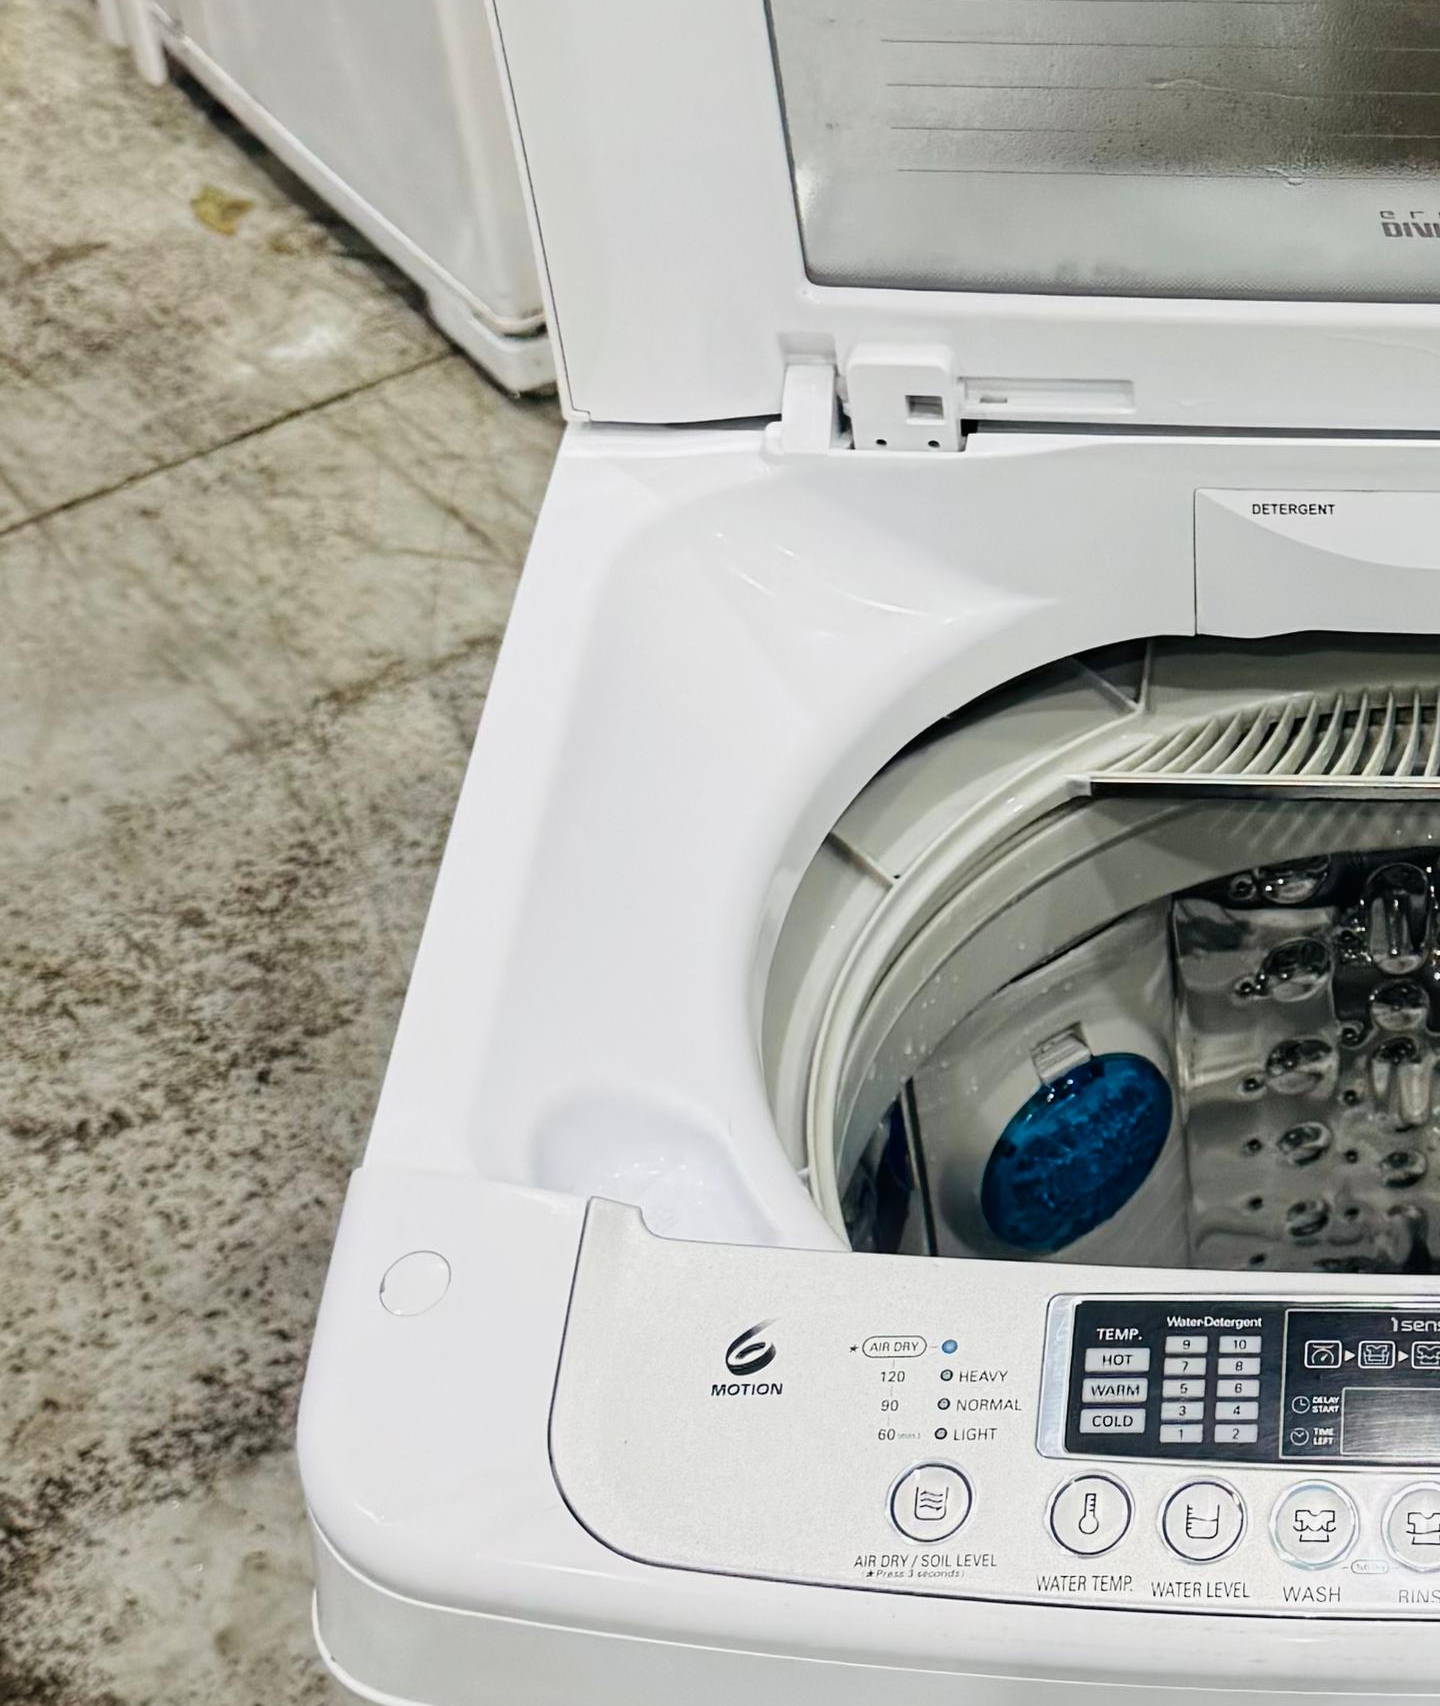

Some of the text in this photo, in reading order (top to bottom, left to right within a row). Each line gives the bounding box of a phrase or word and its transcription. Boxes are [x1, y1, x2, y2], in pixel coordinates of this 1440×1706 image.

[1251, 503, 1336, 516] DETERGENT
[1096, 1328, 1143, 1341] TEMP.
[869, 1341, 920, 1352] AIR DRY
[1182, 1339, 1191, 1350] 9
[1233, 1339, 1248, 1350] 10
[1102, 1354, 1133, 1366] HOT
[1182, 1361, 1189, 1372] 7
[1235, 1360, 1244, 1372] 8
[880, 1370, 906, 1383] 120
[958, 1370, 1009, 1383] HEAVY
[711, 1381, 784, 1397] MOTION
[1091, 1384, 1140, 1397] WARM
[1179, 1383, 1188, 1394] 5
[1234, 1382, 1243, 1394] 6
[880, 1399, 899, 1412] 90
[956, 1398, 1022, 1411] NORMAL
[1312, 1396, 1340, 1404] DELAY
[1178, 1405, 1187, 1416] 3
[1233, 1405, 1241, 1416] 4
[1311, 1405, 1340, 1413] START
[1091, 1415, 1134, 1428] COLD
[878, 1428, 896, 1441] 60
[953, 1428, 998, 1441] LIGHT
[1232, 1428, 1240, 1440] 2
[854, 1554, 877, 1568] AIR
[880, 1554, 909, 1568] DRY
[921, 1554, 952, 1568] SOIL
[956, 1554, 998, 1567] LEVEL
[1036, 1574, 1134, 1592] WATER TEMP.
[1151, 1580, 1250, 1599] WATER LEVEL
[1282, 1586, 1342, 1603] WASH
